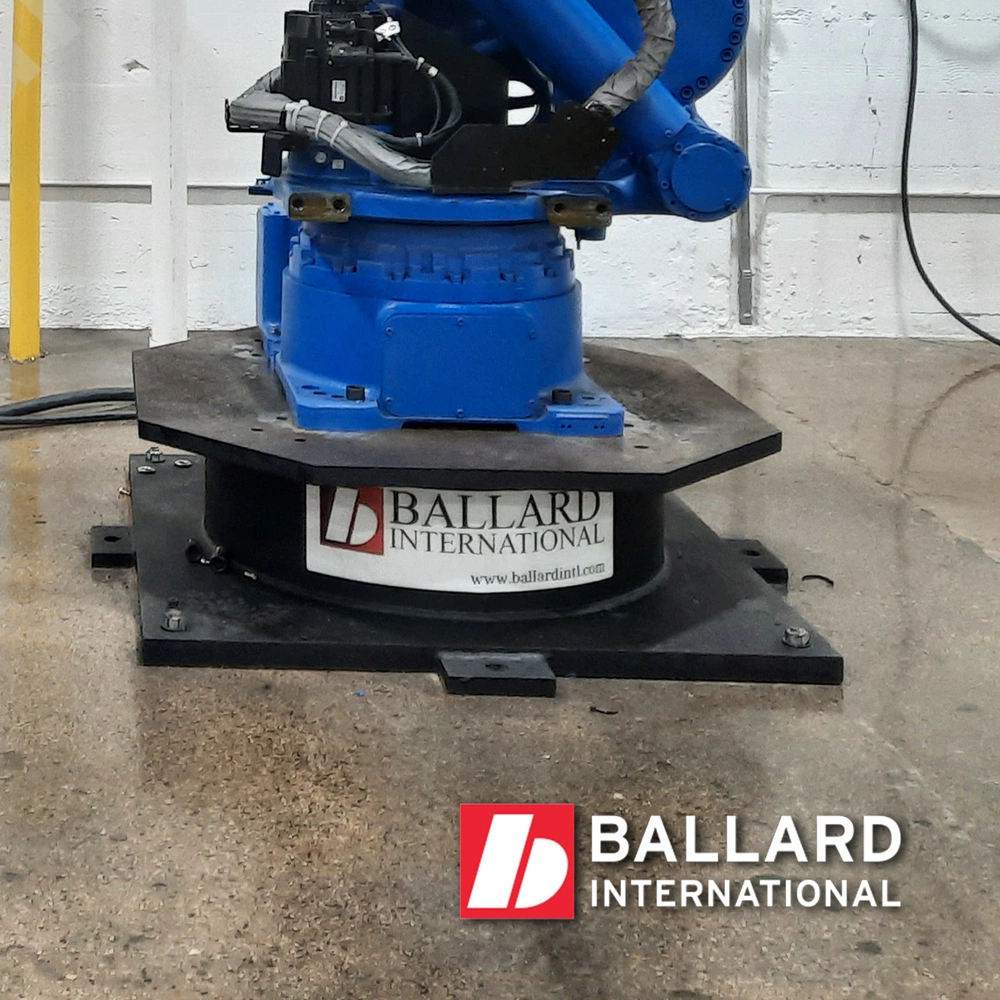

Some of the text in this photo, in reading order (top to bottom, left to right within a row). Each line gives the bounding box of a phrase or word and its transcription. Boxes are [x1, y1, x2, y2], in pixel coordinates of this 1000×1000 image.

[389, 489, 601, 530] BALLARD
[389, 522, 605, 556] INTERNATIONAL
[471, 562, 606, 586] www.ballardintl.com
